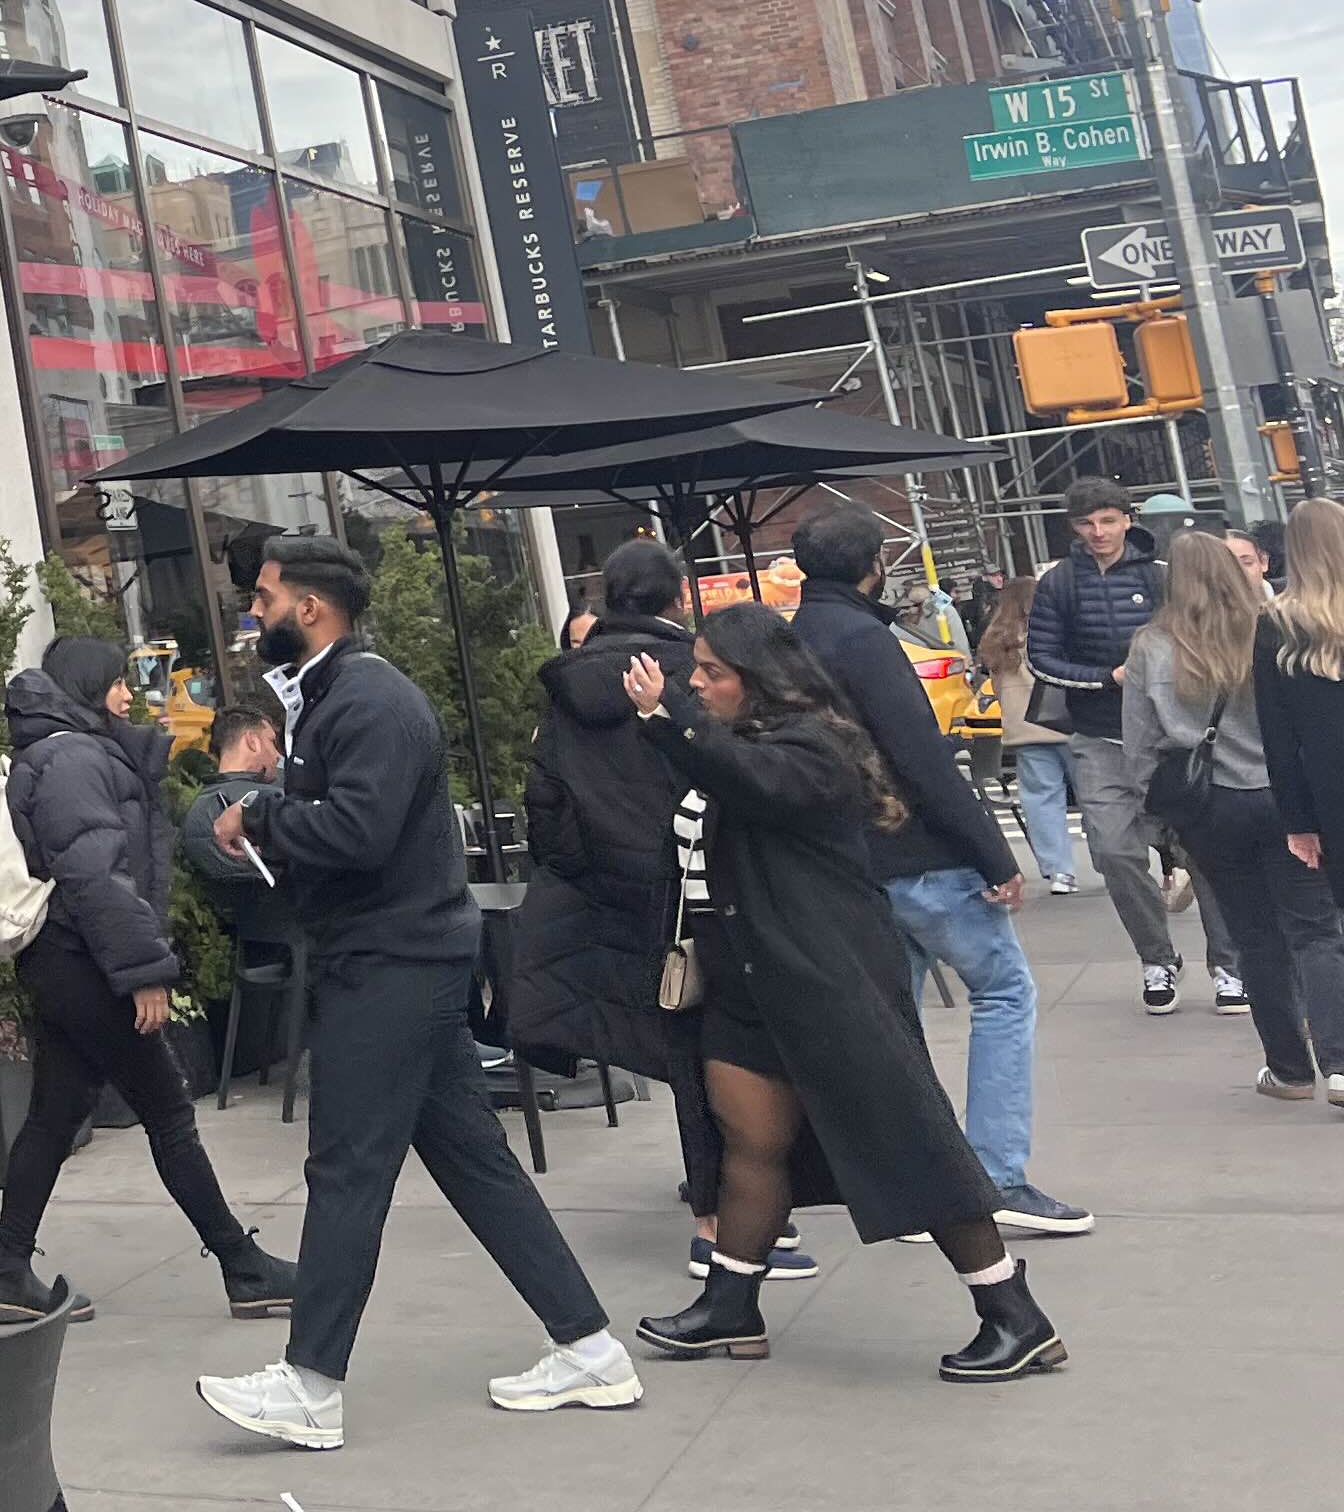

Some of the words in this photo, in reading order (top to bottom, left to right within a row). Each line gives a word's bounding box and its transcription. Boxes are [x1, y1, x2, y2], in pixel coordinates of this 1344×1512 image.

[491, 63, 507, 80] R
[1004, 91, 1029, 124] W
[1042, 85, 1077, 119] 15
[1089, 78, 1110, 99] St
[973, 136, 1029, 162] Irwin
[1035, 131, 1057, 154] B.
[1063, 125, 1131, 150] Cohen
[1041, 155, 1067, 169] Way
[501, 116, 534, 219] RESERVE
[1122, 240, 1175, 265] ONE
[1215, 227, 1272, 255] WAY
[522, 233, 558, 349] TARBUCKS
